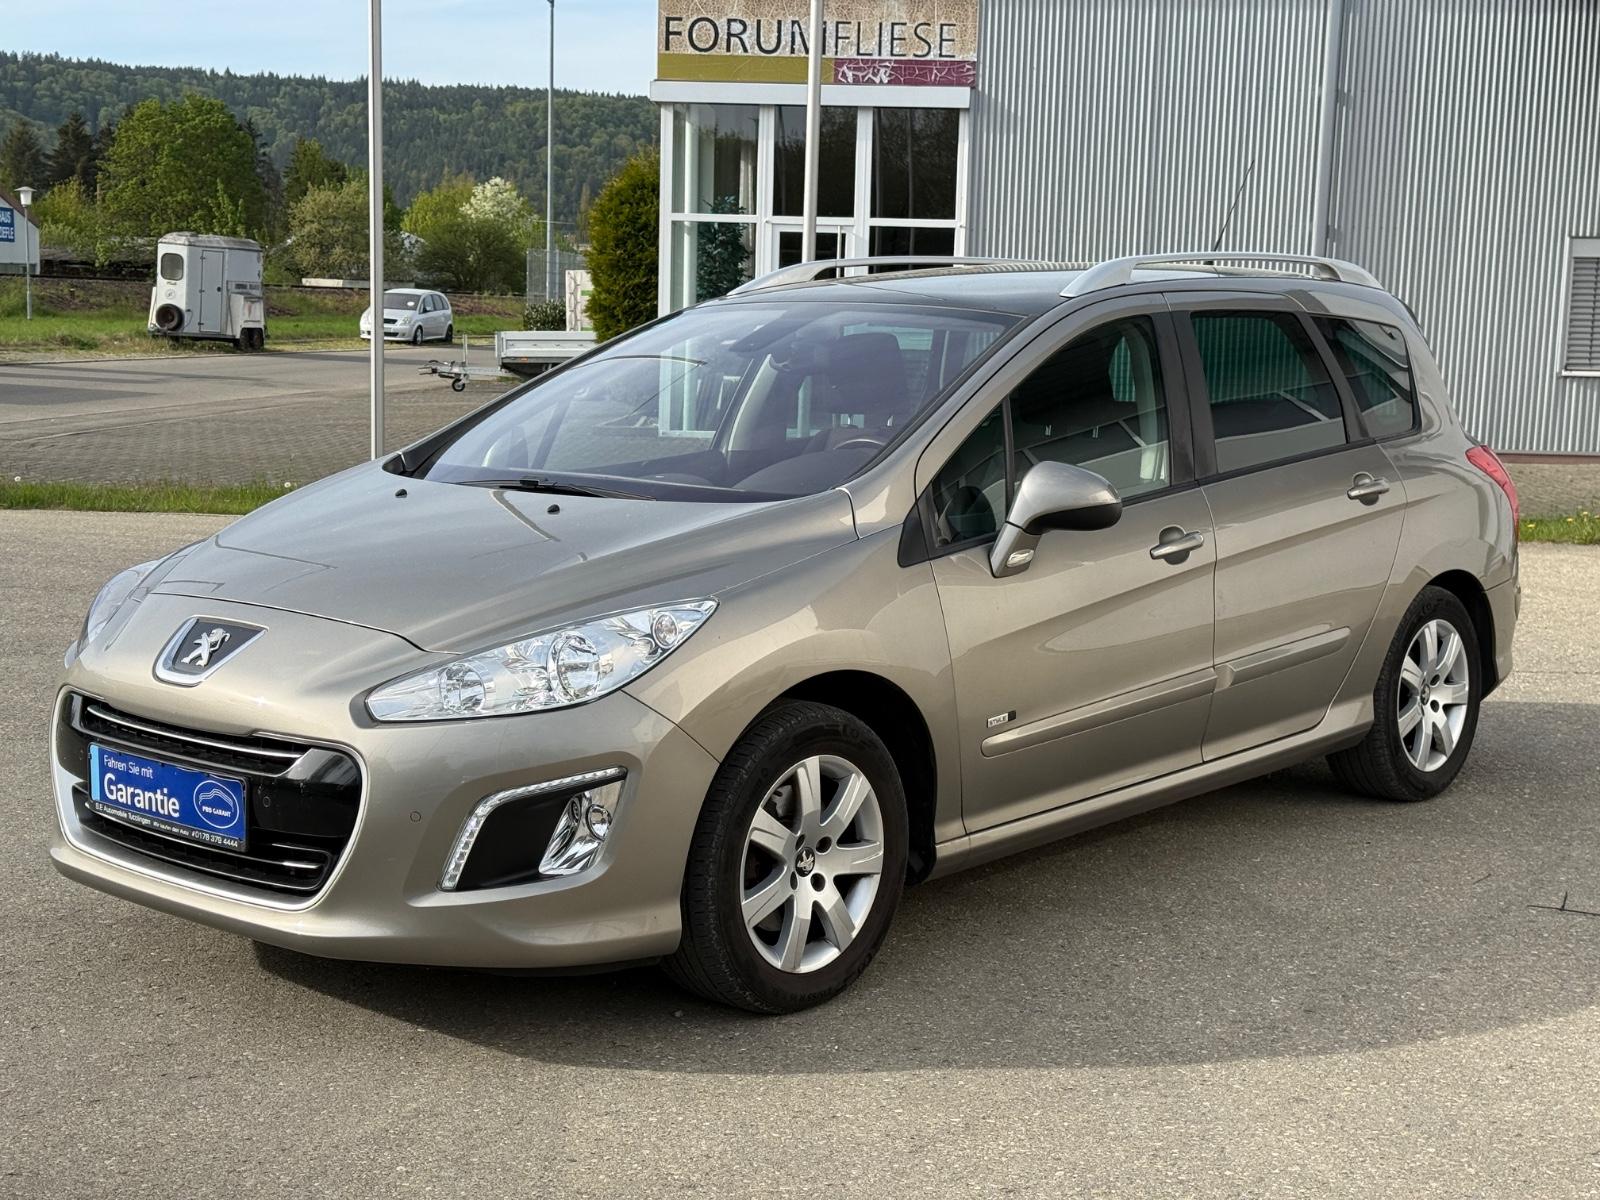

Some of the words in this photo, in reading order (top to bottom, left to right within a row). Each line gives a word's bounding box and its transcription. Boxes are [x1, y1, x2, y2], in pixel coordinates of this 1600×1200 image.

[104, 755, 127, 772] Fahren
[128, 762, 140, 775] Sie
[141, 766, 154, 779] mit
[104, 773, 180, 817] Garantie
